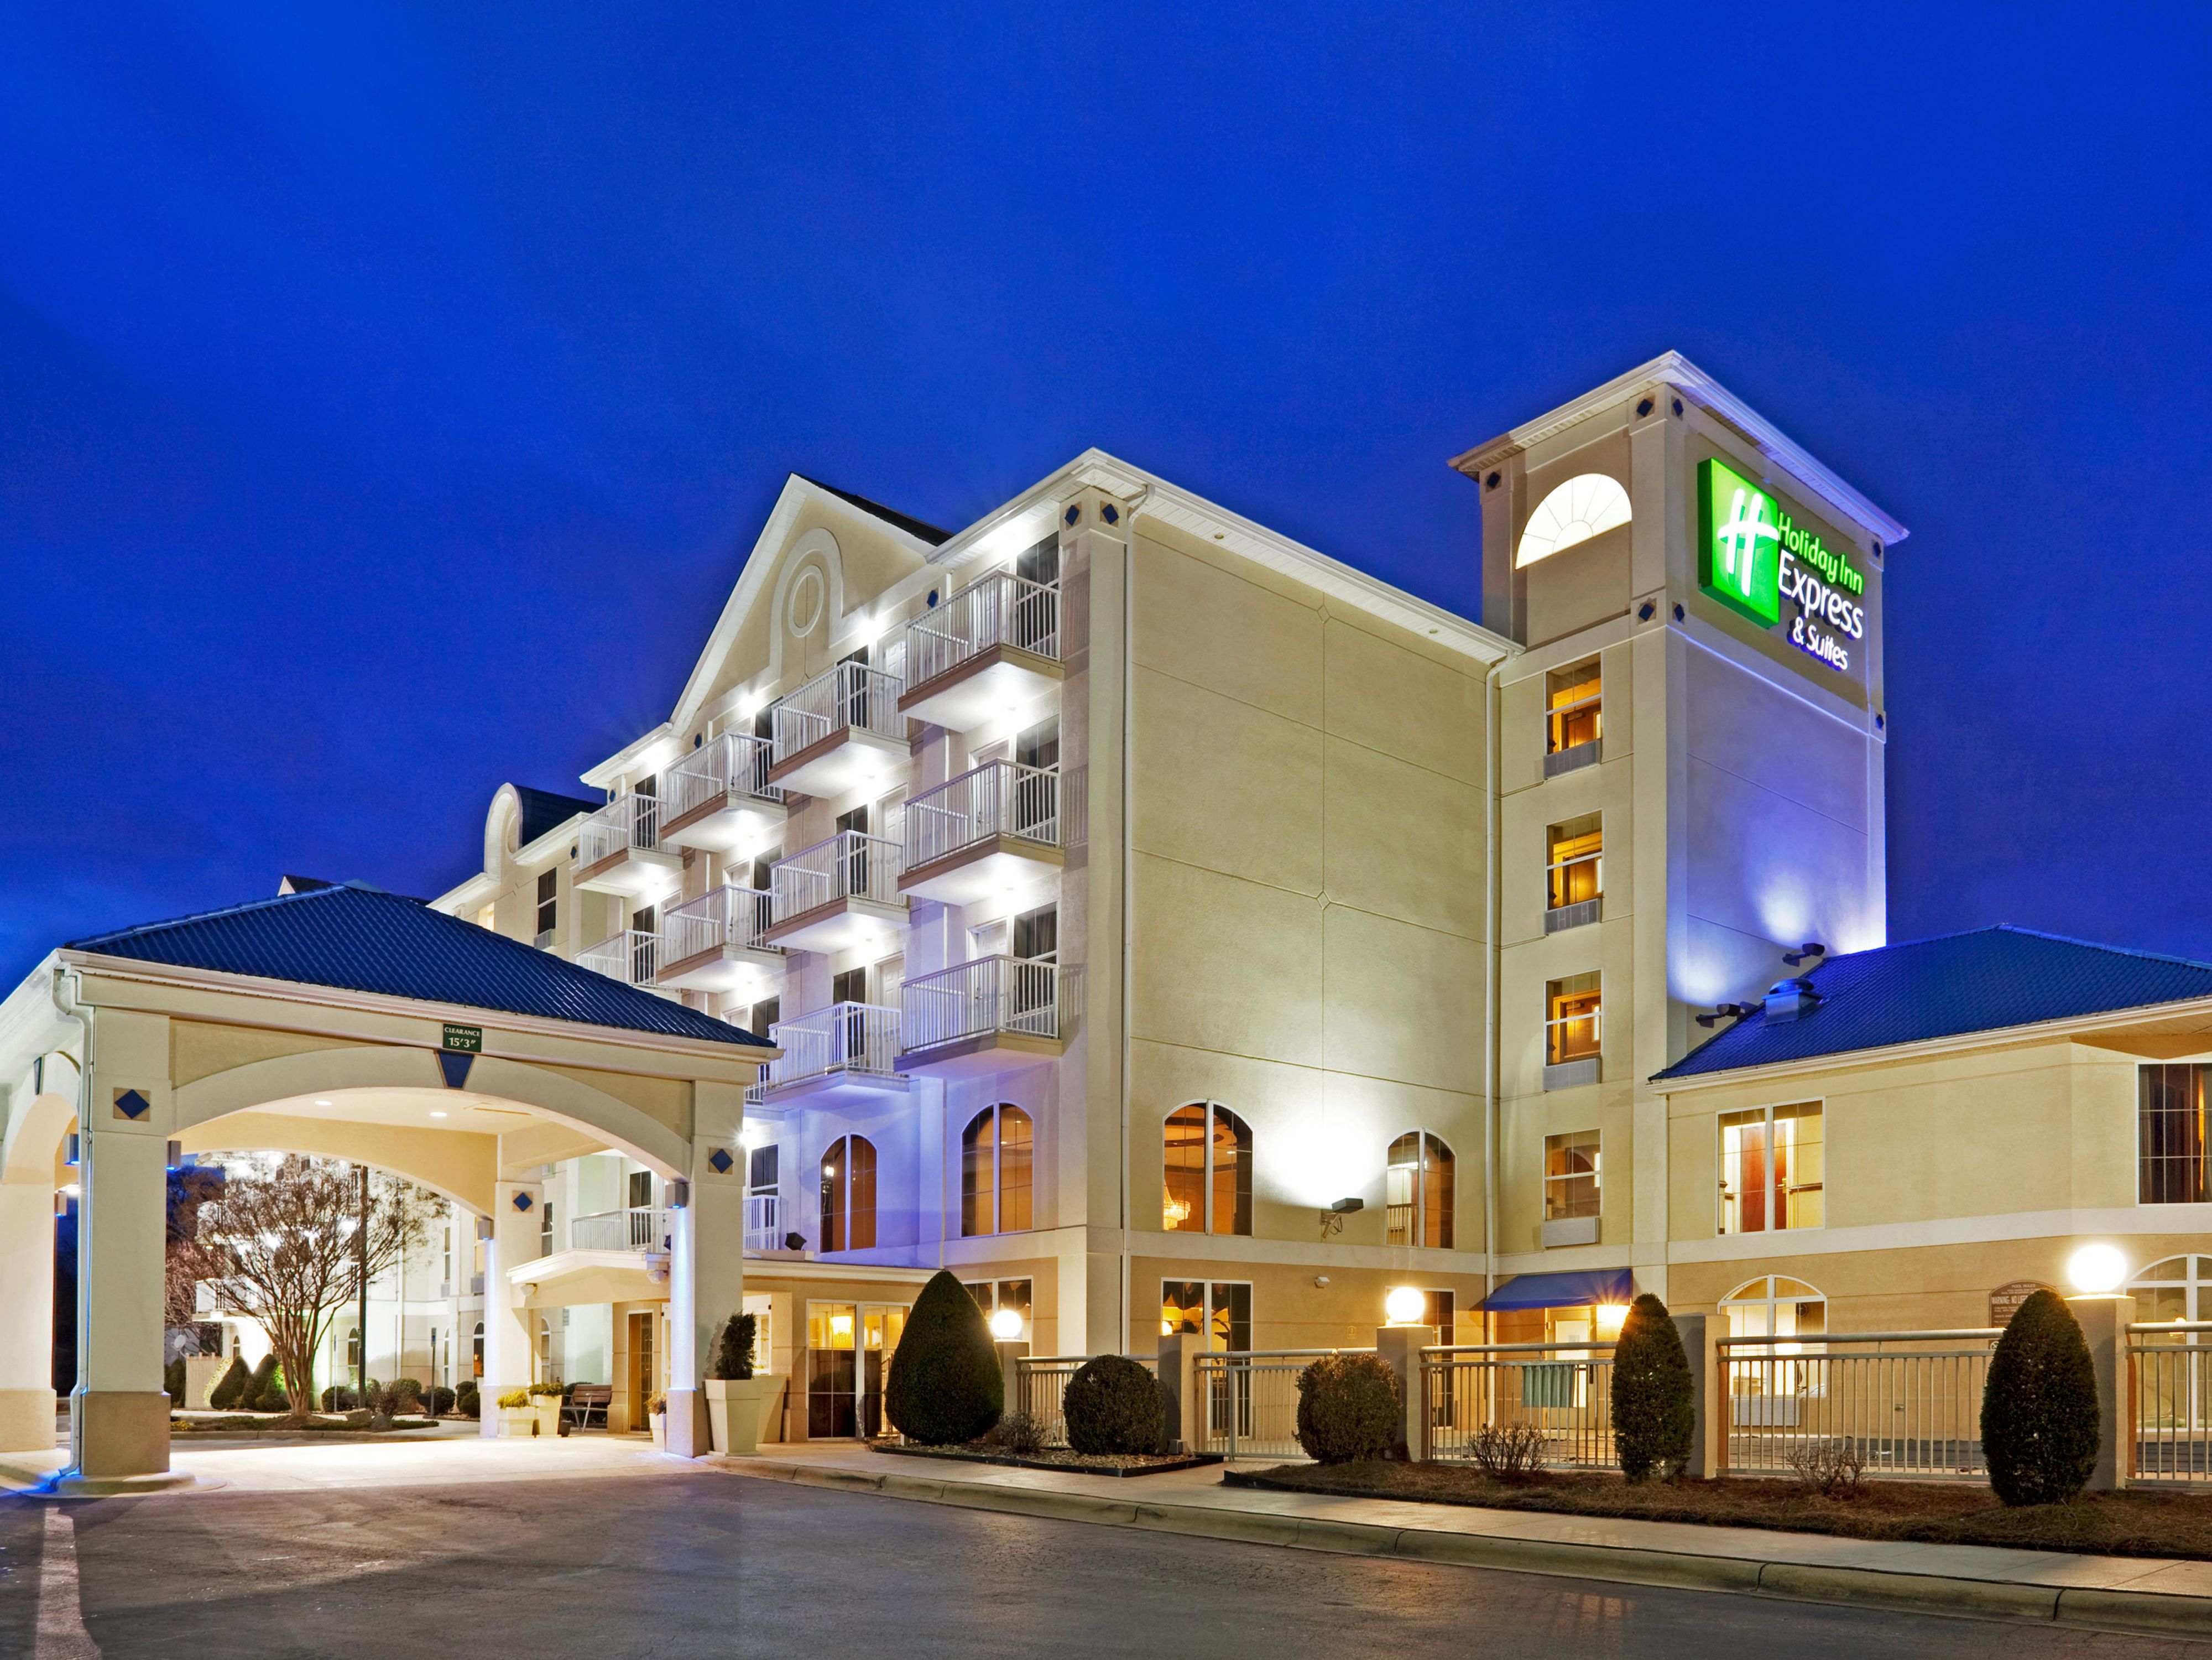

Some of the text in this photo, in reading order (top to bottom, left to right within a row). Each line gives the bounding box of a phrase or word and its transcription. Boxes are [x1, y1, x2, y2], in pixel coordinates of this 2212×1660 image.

[1778, 512, 1864, 595] Holiday Inn
[1778, 549, 1864, 639] Express
[1792, 616, 1848, 670] & Suites
[445, 1027, 480, 1037] CLEARANCE
[448, 1037, 476, 1048] 15'3"
